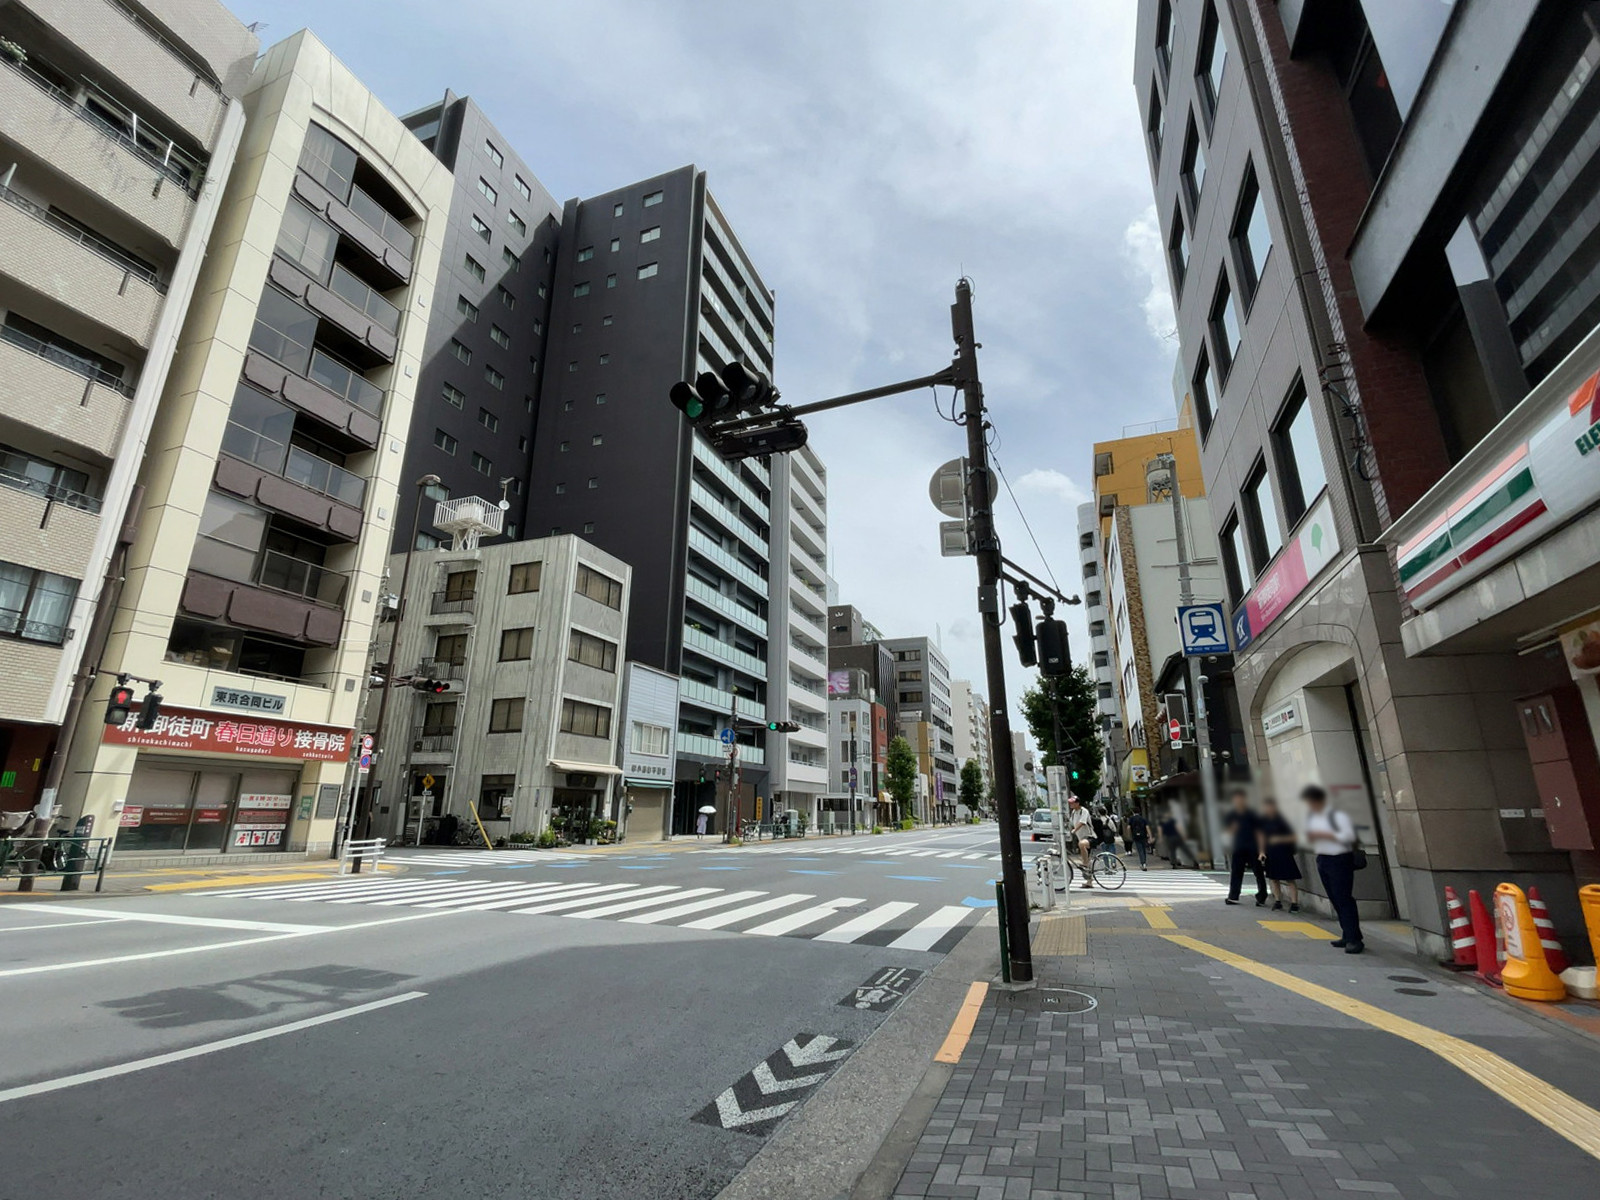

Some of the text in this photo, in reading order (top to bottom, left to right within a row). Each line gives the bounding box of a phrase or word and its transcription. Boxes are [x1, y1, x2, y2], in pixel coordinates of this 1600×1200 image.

[214, 691, 283, 711] 東京合同ビル
